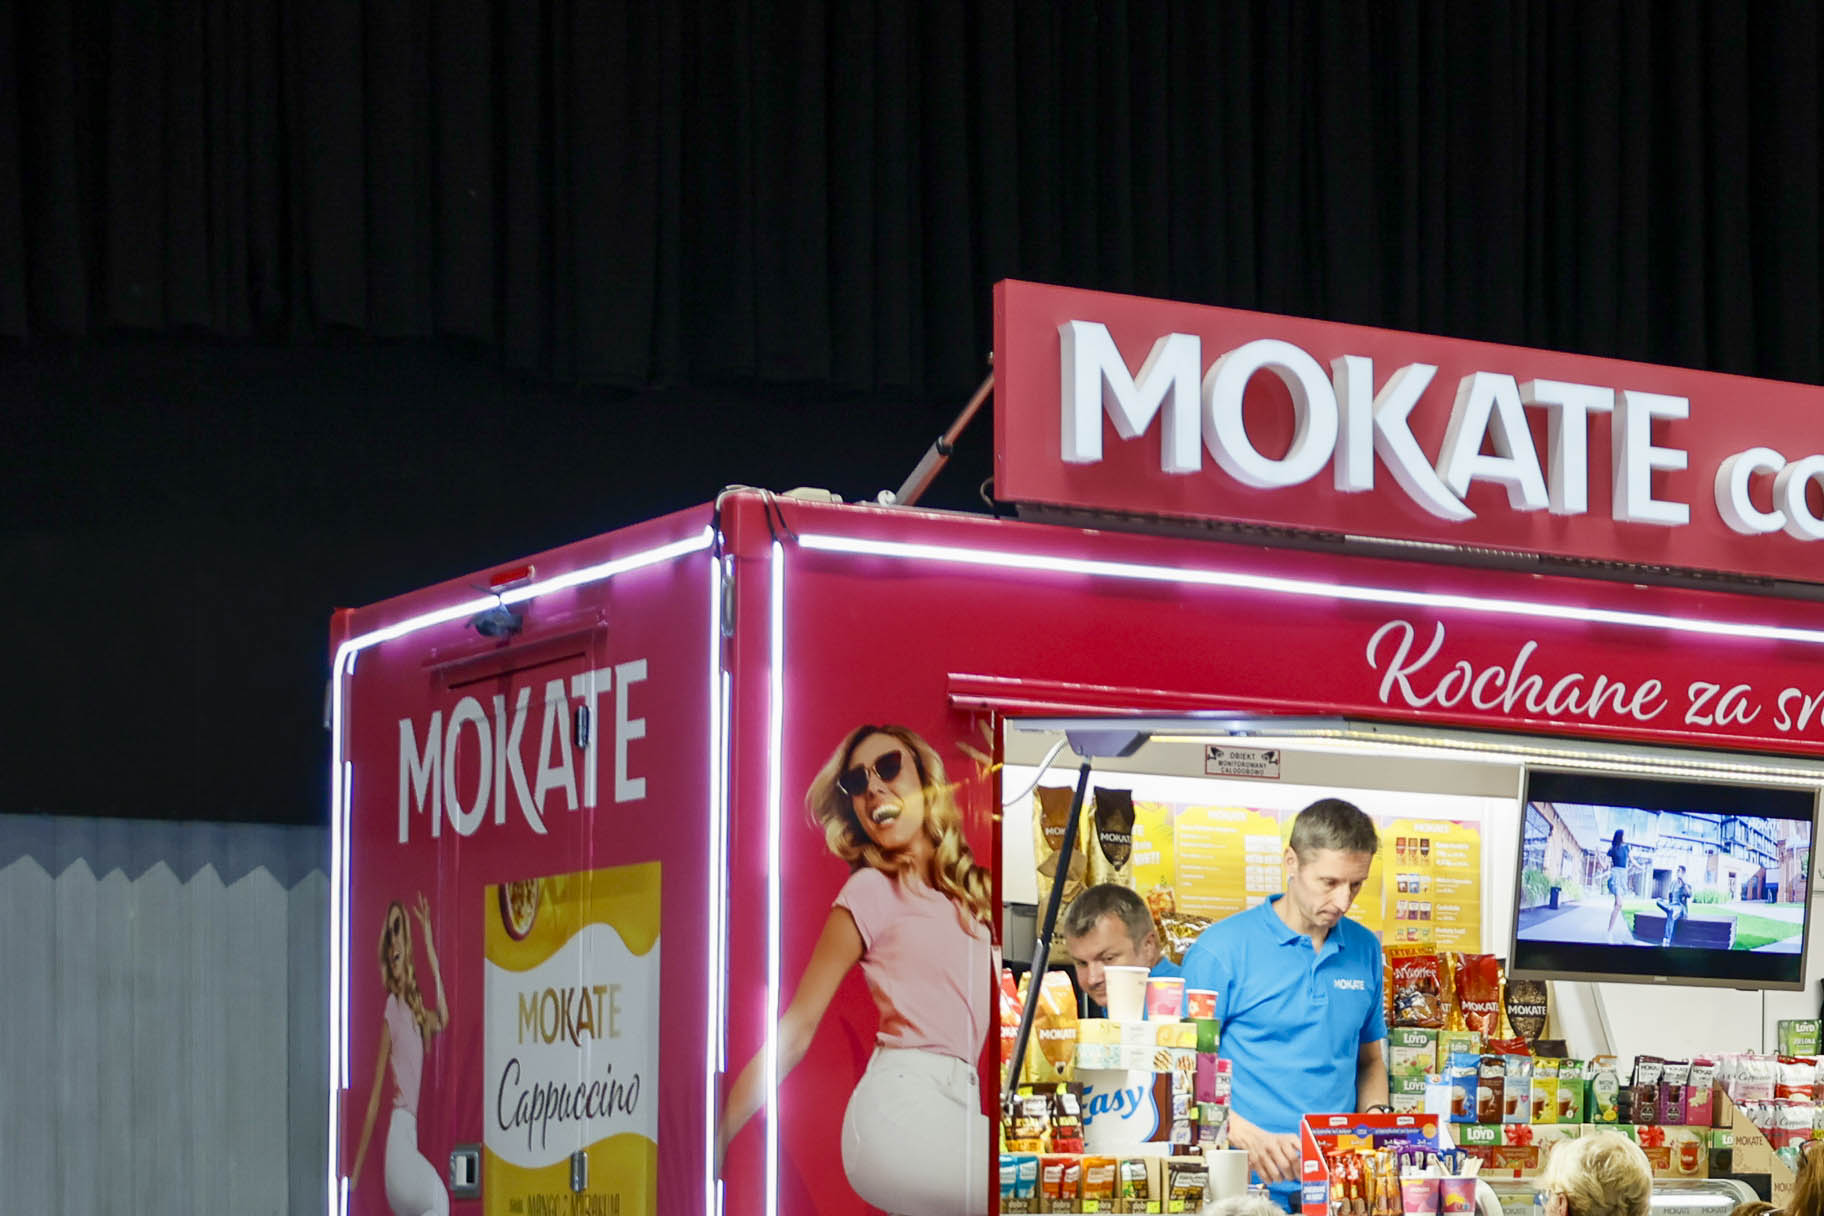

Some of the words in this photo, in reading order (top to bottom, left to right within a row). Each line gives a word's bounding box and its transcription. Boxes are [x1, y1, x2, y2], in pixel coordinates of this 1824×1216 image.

[1058, 320, 1690, 526] MOKATE
[1366, 620, 1667, 721] Kochane
[1685, 682, 1761, 726] za
[398, 658, 648, 844] MOKATE
[518, 983, 624, 1047] MOKATE
[1403, 1032, 1428, 1044] LOYD
[1507, 1004, 1547, 1016] MOKATE
[497, 1057, 641, 1152] Cappuccino
[1467, 1128, 1494, 1141] LOYD
[1736, 1135, 1763, 1146] MOKATE
